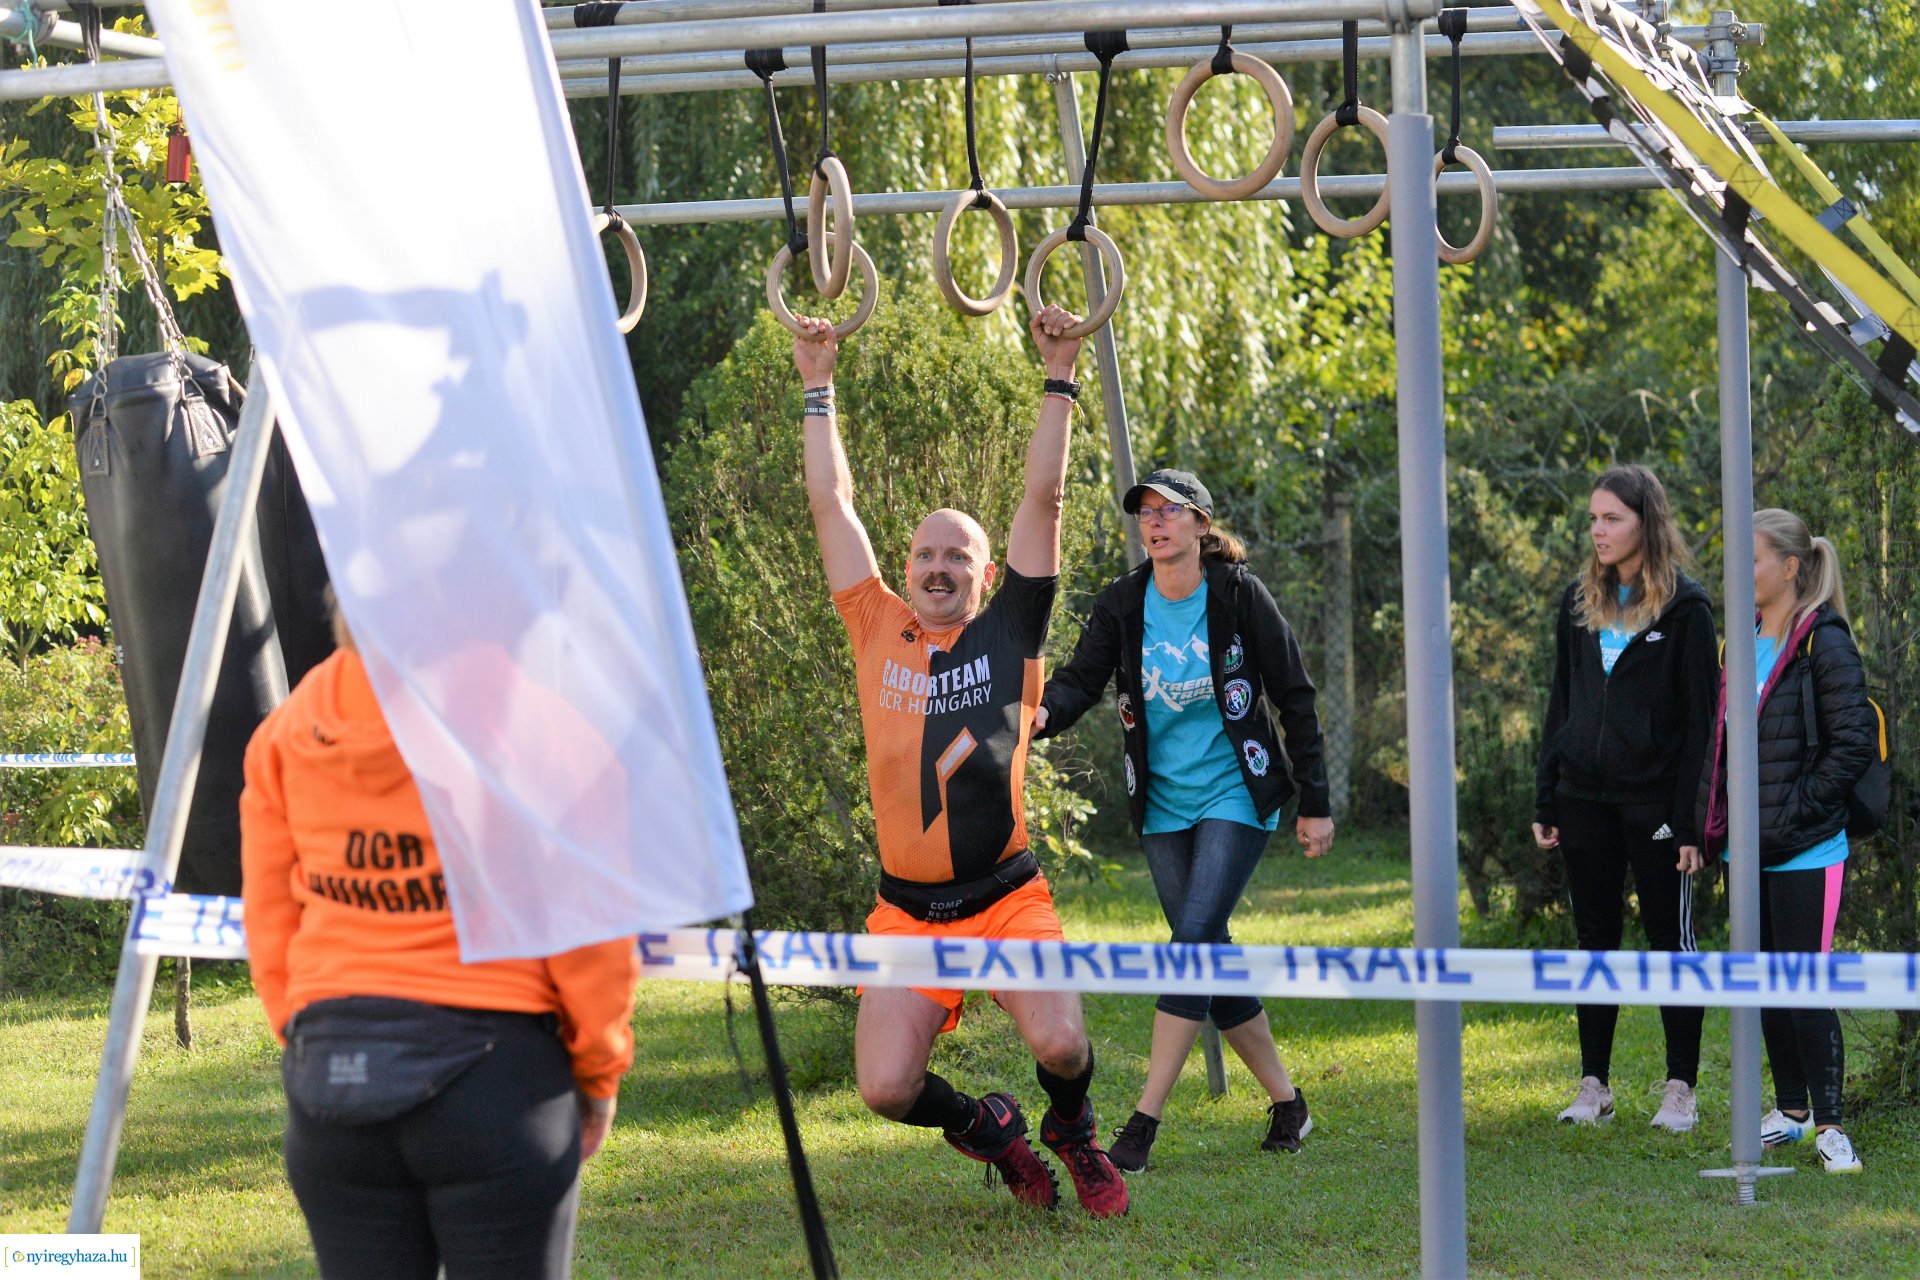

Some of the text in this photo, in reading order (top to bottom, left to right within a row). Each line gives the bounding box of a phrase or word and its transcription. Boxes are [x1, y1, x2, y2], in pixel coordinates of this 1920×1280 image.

[879, 683, 992, 716] OCR HUNGARY
[346, 831, 423, 870] OCR
[928, 910, 958, 919] RESS
[930, 899, 963, 910] COMP
[932, 938, 1249, 980] EXTREME
[1532, 951, 1867, 991] EXTREME
